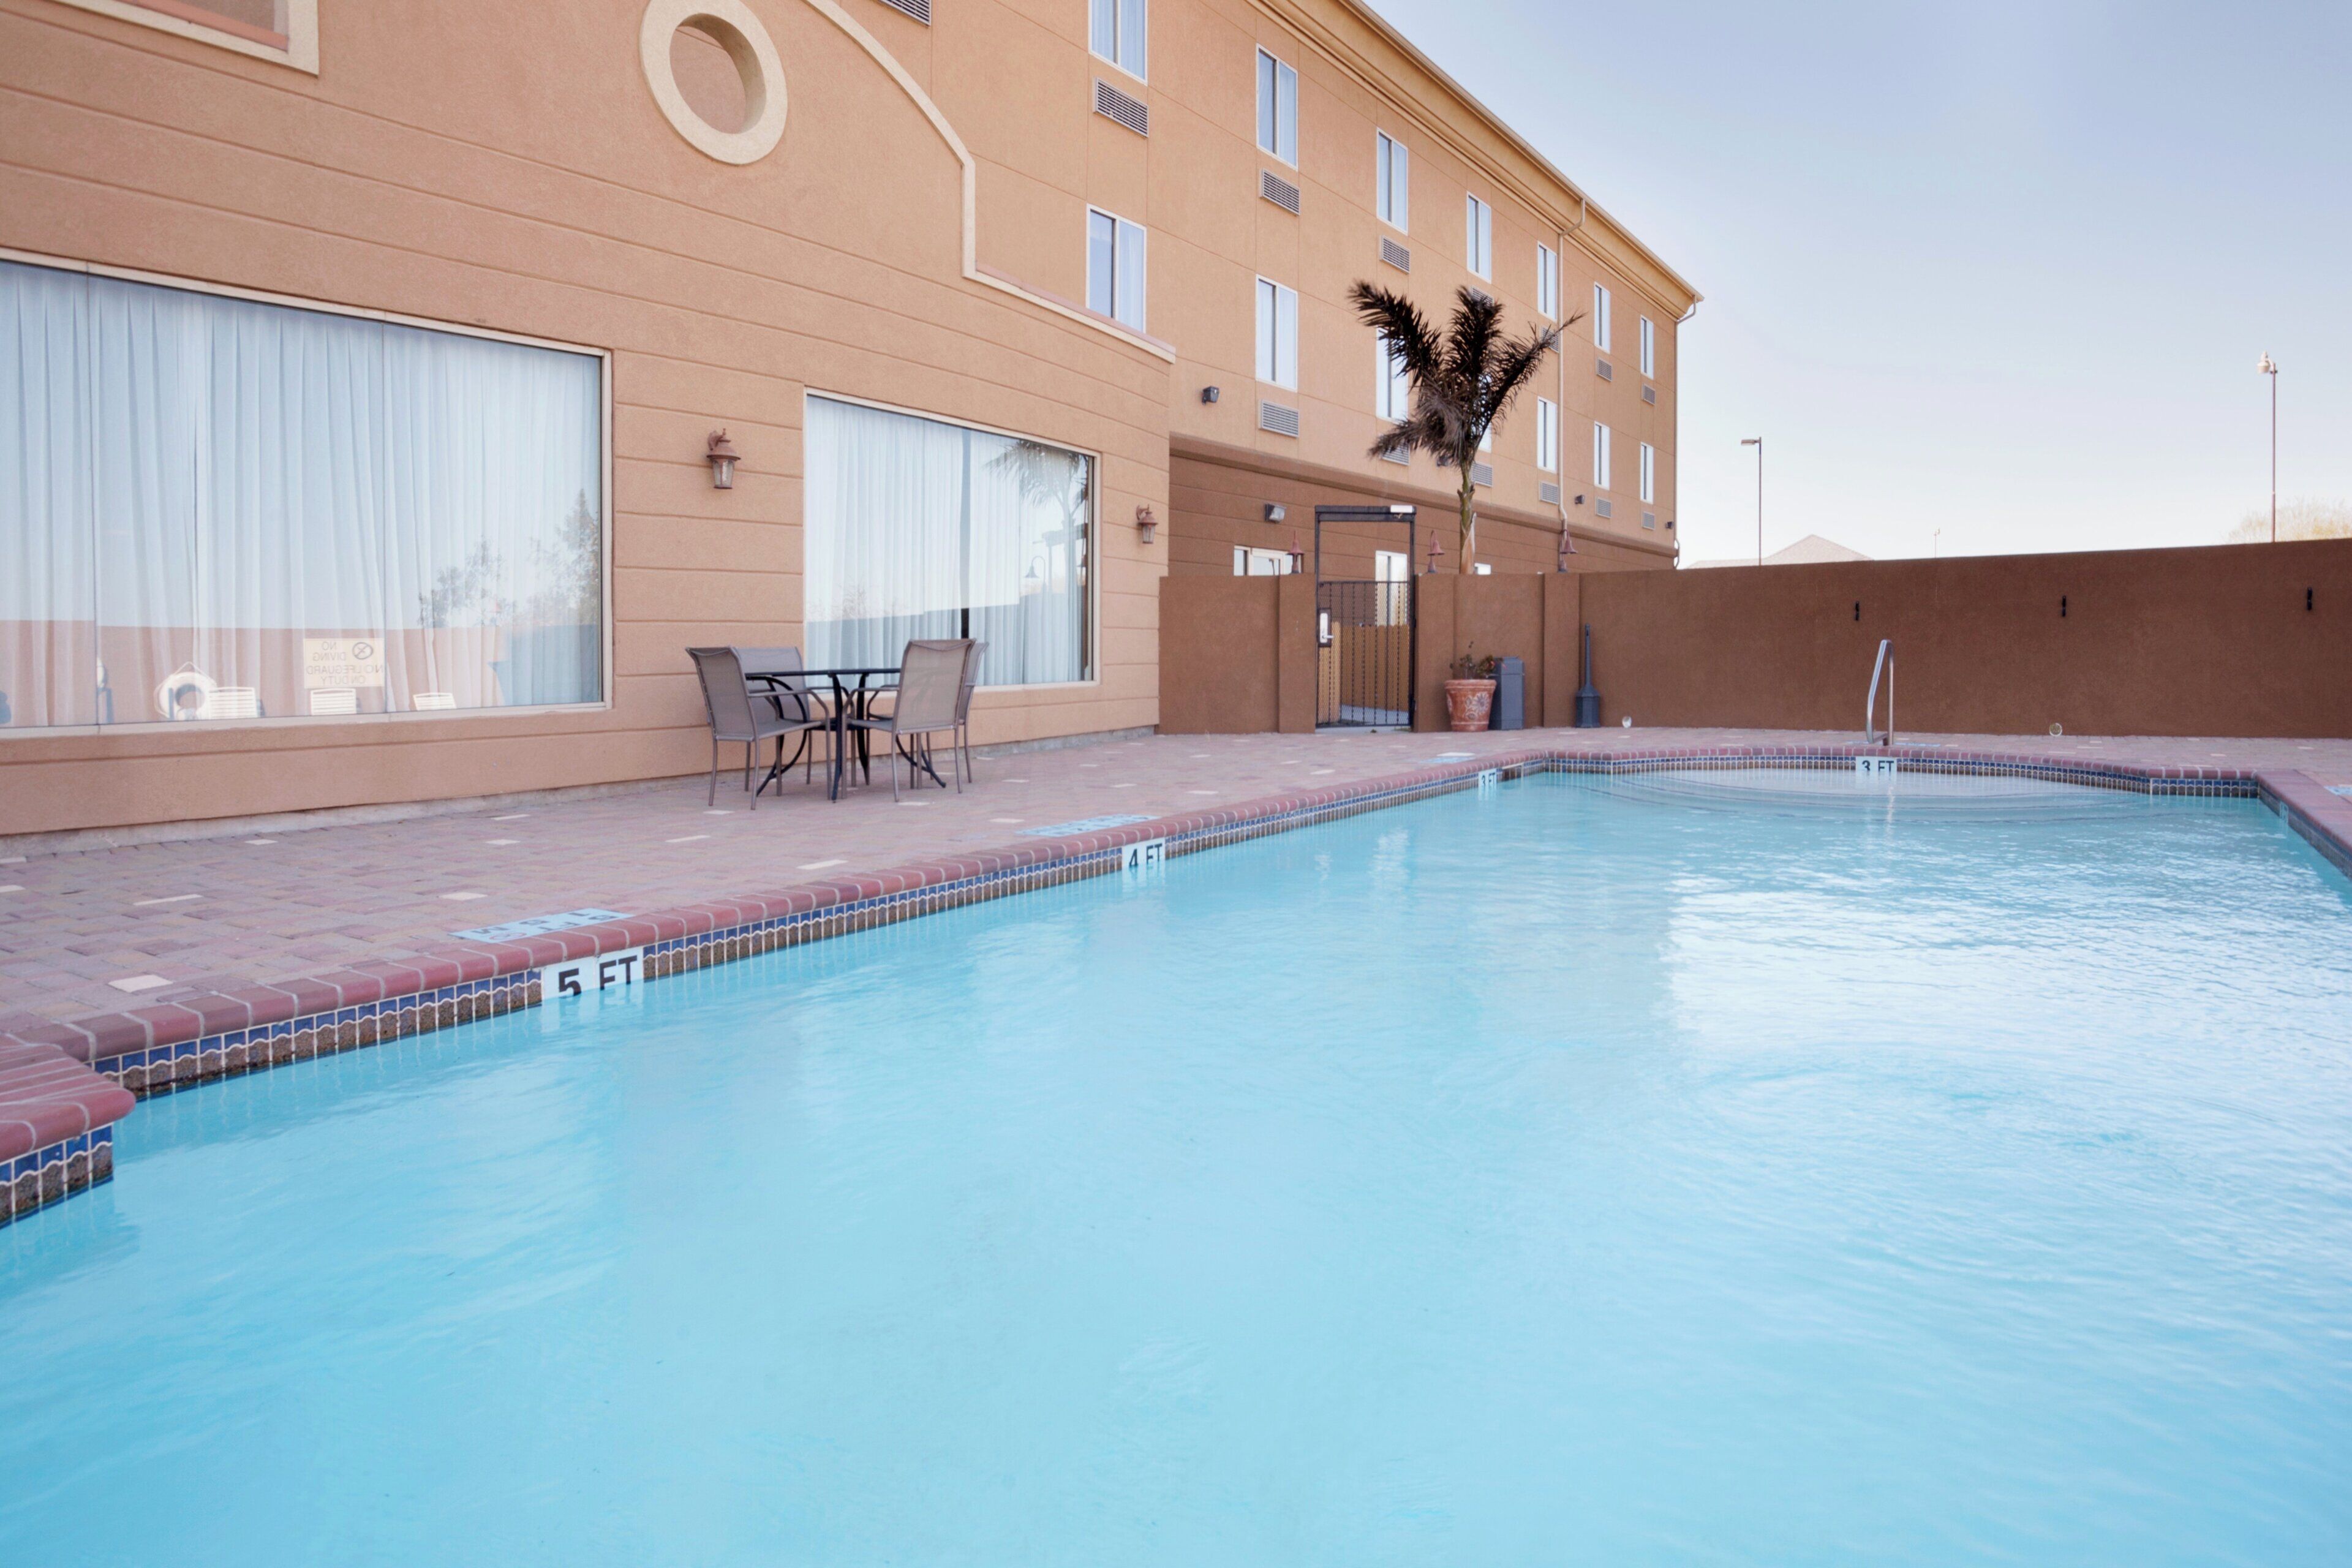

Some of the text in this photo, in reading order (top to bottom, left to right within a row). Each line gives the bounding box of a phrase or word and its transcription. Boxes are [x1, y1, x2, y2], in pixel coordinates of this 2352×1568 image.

[1862, 760, 1894, 772] 3 FT
[1129, 843, 1163, 866] 4 FT
[559, 955, 638, 997] 5 FT
